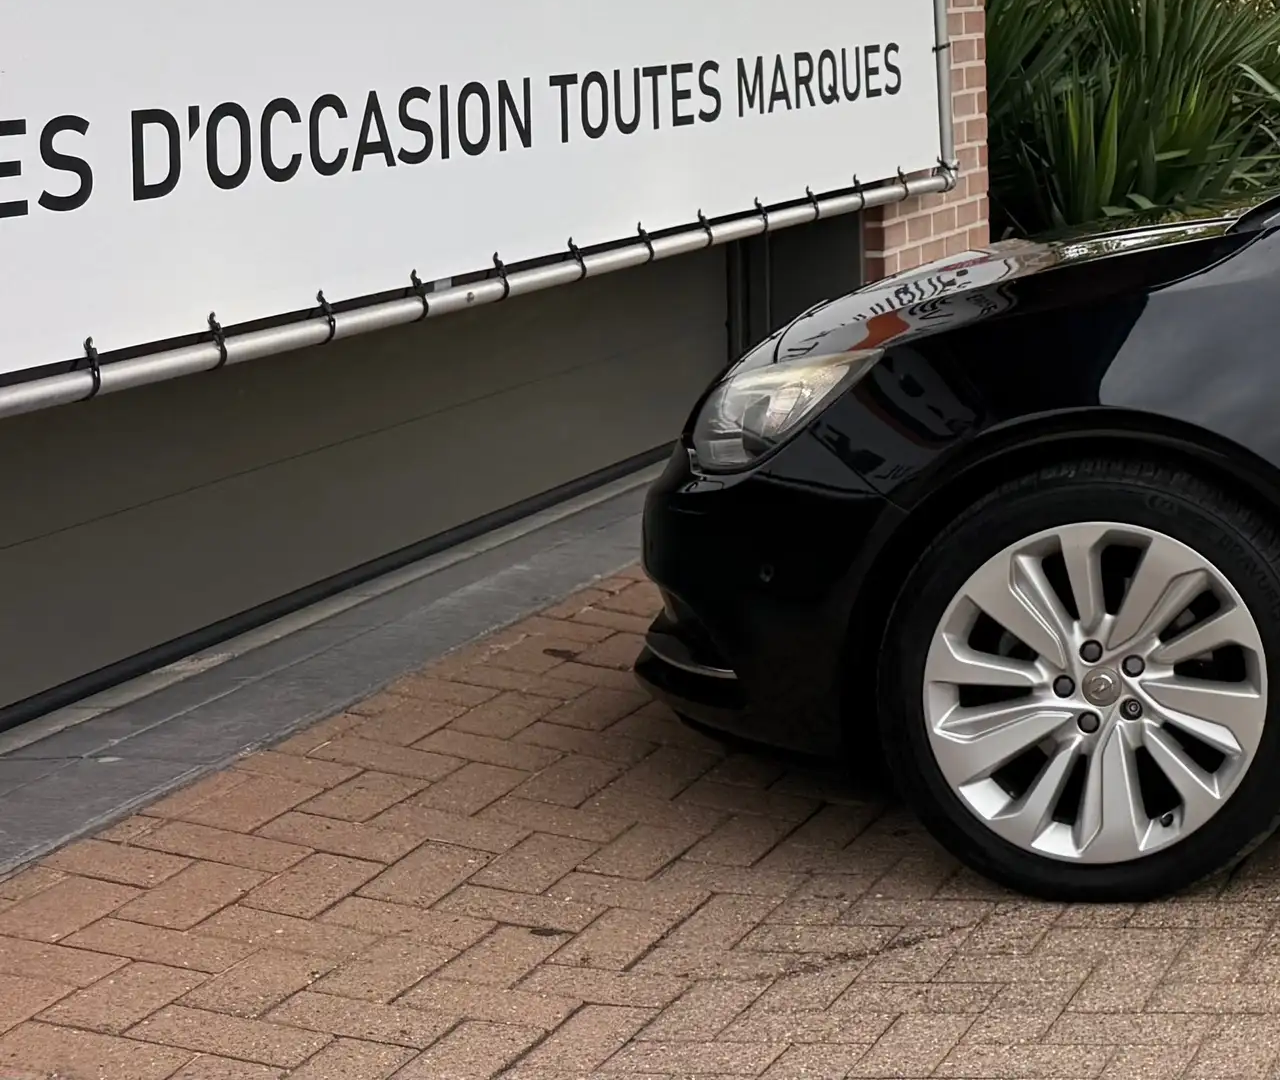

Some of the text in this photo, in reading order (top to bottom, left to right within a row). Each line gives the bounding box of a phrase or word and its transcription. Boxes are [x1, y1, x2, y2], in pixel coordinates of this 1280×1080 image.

[132, 78, 532, 201] D'OCCASION
[550, 61, 722, 144] TOUTES
[738, 43, 901, 118] MARQUES
